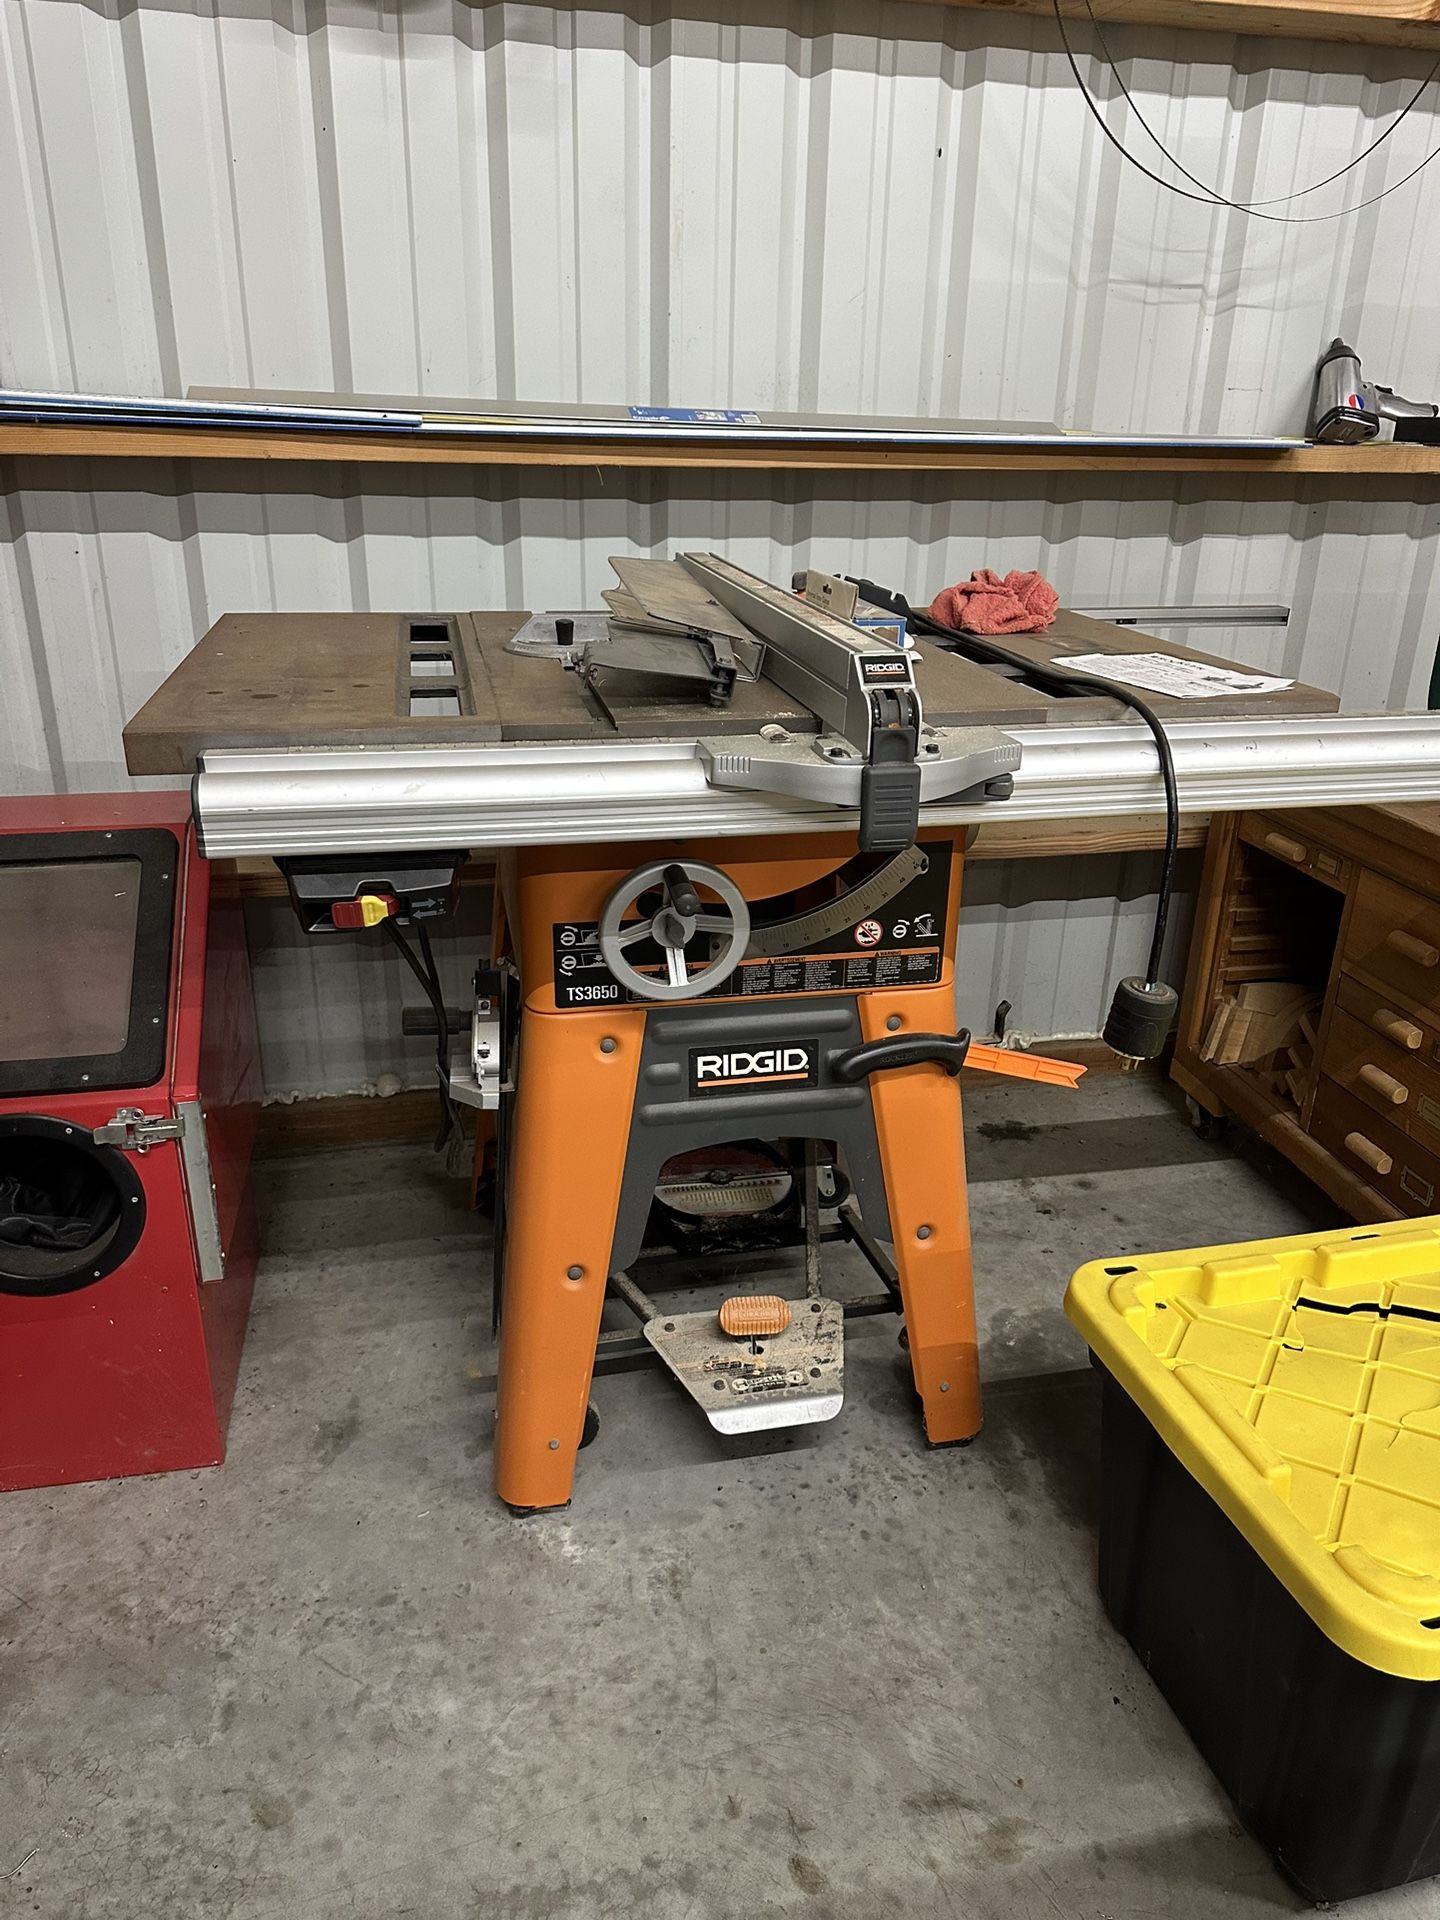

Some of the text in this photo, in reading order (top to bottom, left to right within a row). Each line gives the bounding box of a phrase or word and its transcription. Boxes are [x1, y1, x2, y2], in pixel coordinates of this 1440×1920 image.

[865, 663, 905, 672] RIDGID
[566, 985, 618, 1001] TS3650
[697, 1048, 809, 1078] RIDGID
